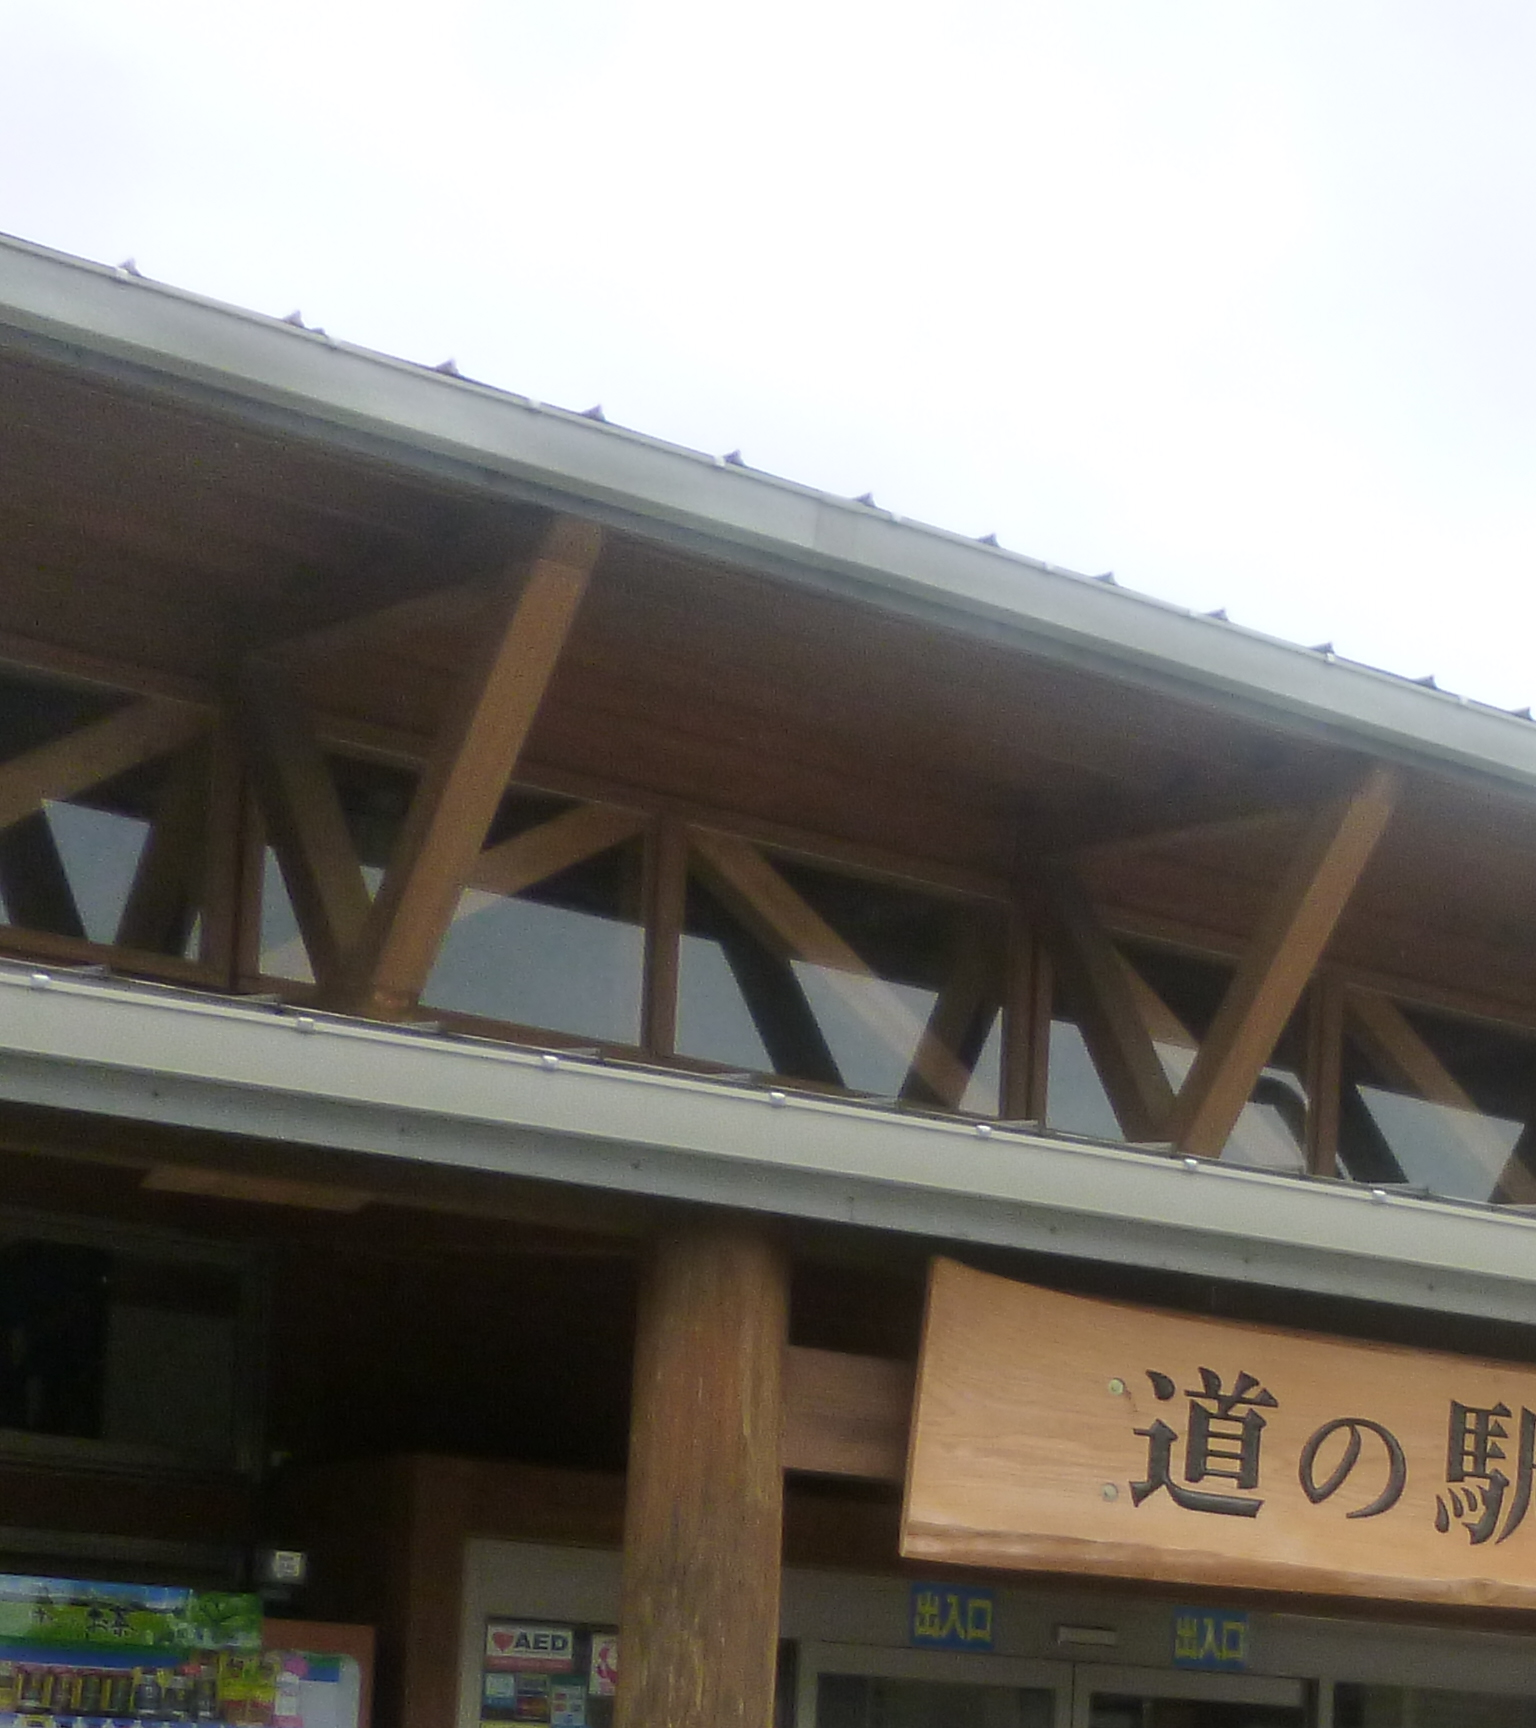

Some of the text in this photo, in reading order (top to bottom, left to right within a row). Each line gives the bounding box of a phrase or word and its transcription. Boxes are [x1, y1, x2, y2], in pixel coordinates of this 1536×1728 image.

[513, 1631, 569, 1651] AED
[913, 1593, 993, 1643] 出入口
[1174, 1615, 1246, 1662] 出入口
